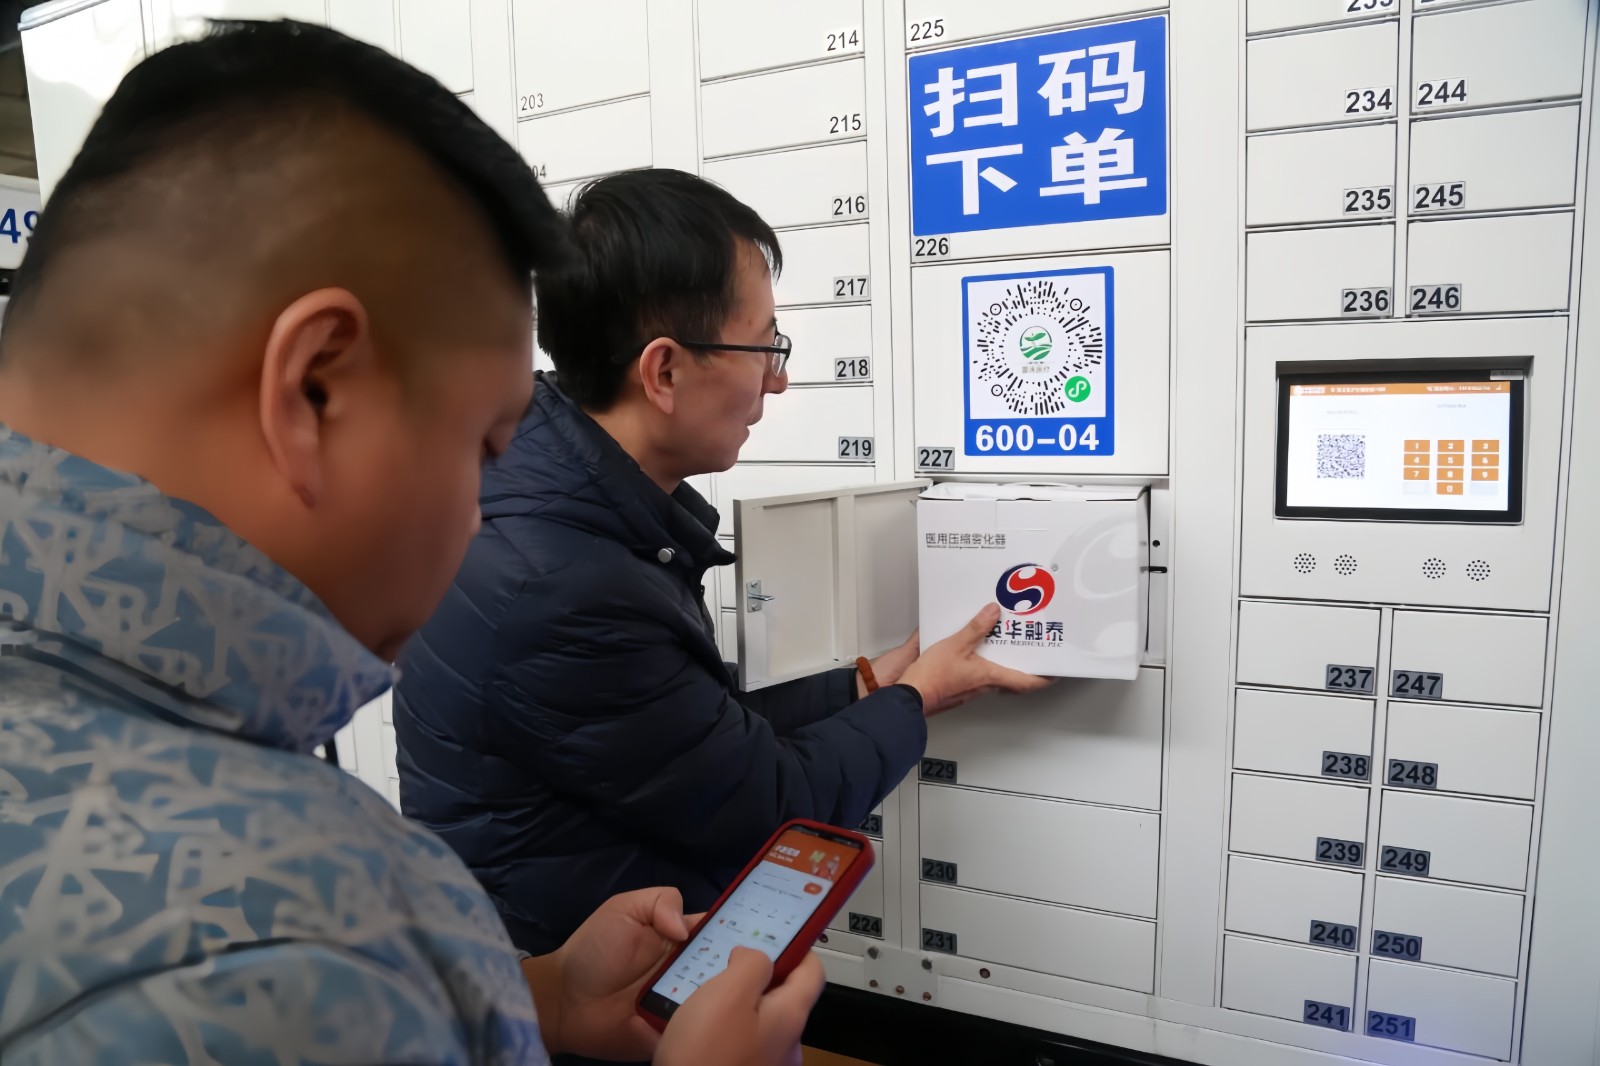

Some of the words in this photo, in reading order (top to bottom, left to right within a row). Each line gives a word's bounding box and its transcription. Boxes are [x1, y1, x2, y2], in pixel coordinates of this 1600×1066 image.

[826, 30, 859, 52] 214
[910, 19, 945, 42] 225
[923, 40, 1145, 138] 扫码
[1417, 79, 1467, 106] 244
[520, 93, 544, 111] 203
[1345, 88, 1392, 114] 234
[829, 113, 861, 134] 215
[926, 127, 1148, 216] 下单
[833, 195, 865, 216] 216
[1345, 188, 1391, 212] 235
[1414, 183, 1463, 209] 245
[915, 237, 949, 257] 226
[835, 278, 867, 297] 217
[1412, 286, 1460, 311] 246
[1343, 289, 1389, 312] 236
[836, 358, 868, 378] 218
[840, 439, 872, 457] 219
[975, 423, 1100, 452] 600-04
[919, 449, 953, 467] 227
[925, 532, 1006, 545] 医用压缩雾化器
[1328, 667, 1372, 689] 237
[1395, 673, 1441, 695] 247
[922, 760, 956, 780] 229
[1324, 754, 1367, 777] 238
[1390, 762, 1435, 786] 248
[1319, 840, 1361, 863] 239
[1383, 848, 1428, 872] 249
[924, 861, 956, 881] 230
[851, 915, 881, 933] 224
[1312, 923, 1354, 947] 240
[924, 931, 954, 950] 231
[1375, 933, 1420, 957] 250
[1306, 1003, 1345, 1027] 241
[1369, 1013, 1411, 1037] 251
